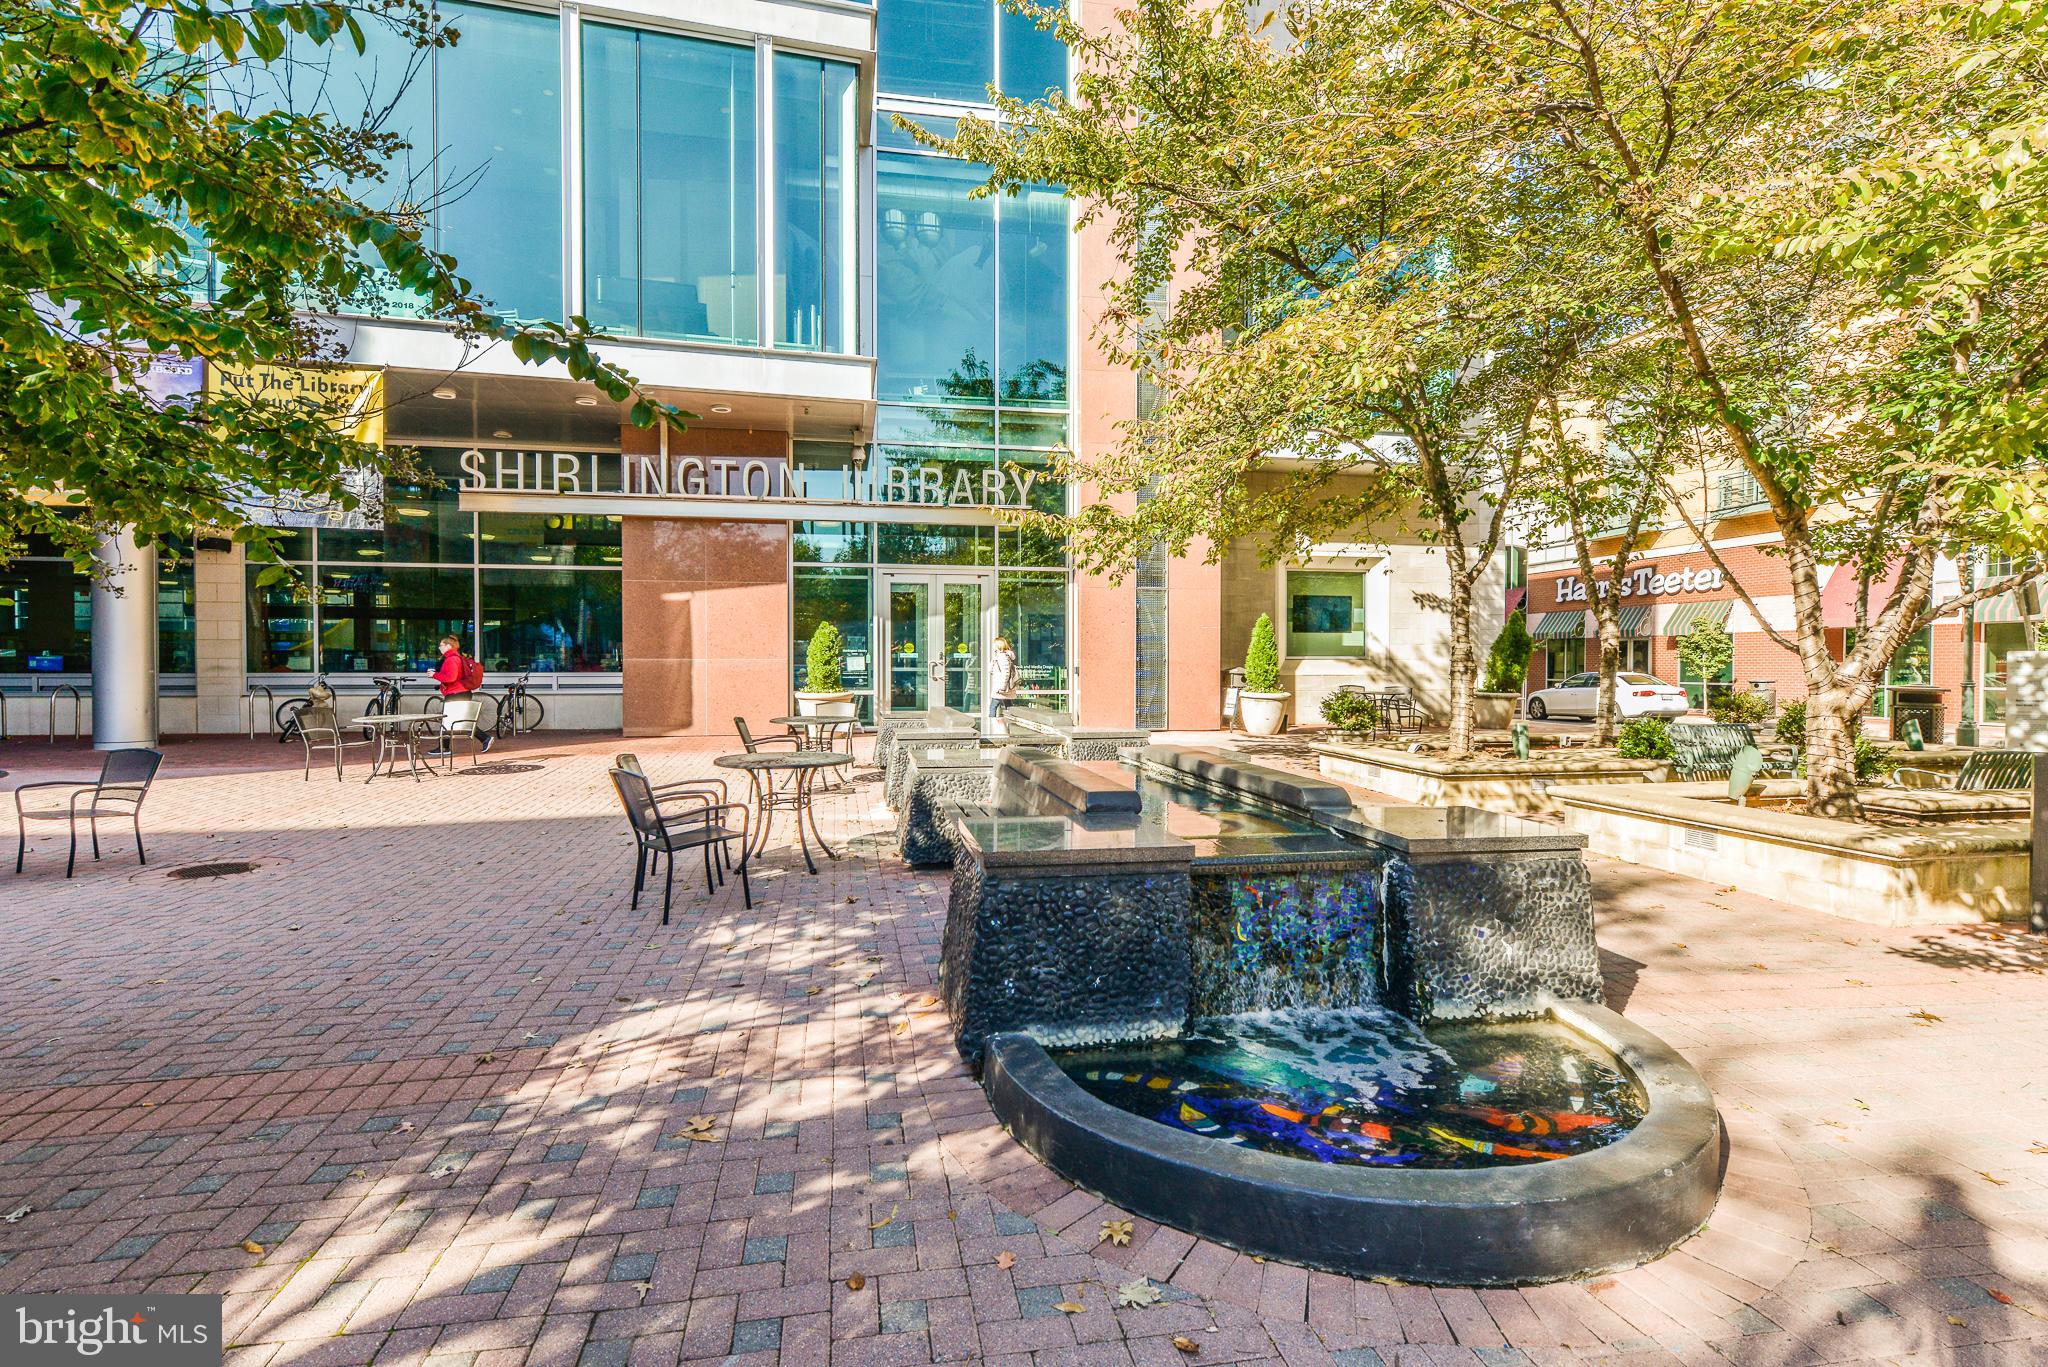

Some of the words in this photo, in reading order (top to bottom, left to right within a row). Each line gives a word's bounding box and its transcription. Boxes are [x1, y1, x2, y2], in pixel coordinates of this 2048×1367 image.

[392, 301, 414, 309] 2018
[221, 373, 254, 388] Put
[259, 373, 293, 390] The
[459, 450, 805, 499] SHIRLINGTON
[842, 463, 1037, 508] LIBRARY
[1555, 577, 1632, 602] Hars
[1633, 566, 1725, 596] Teeter
